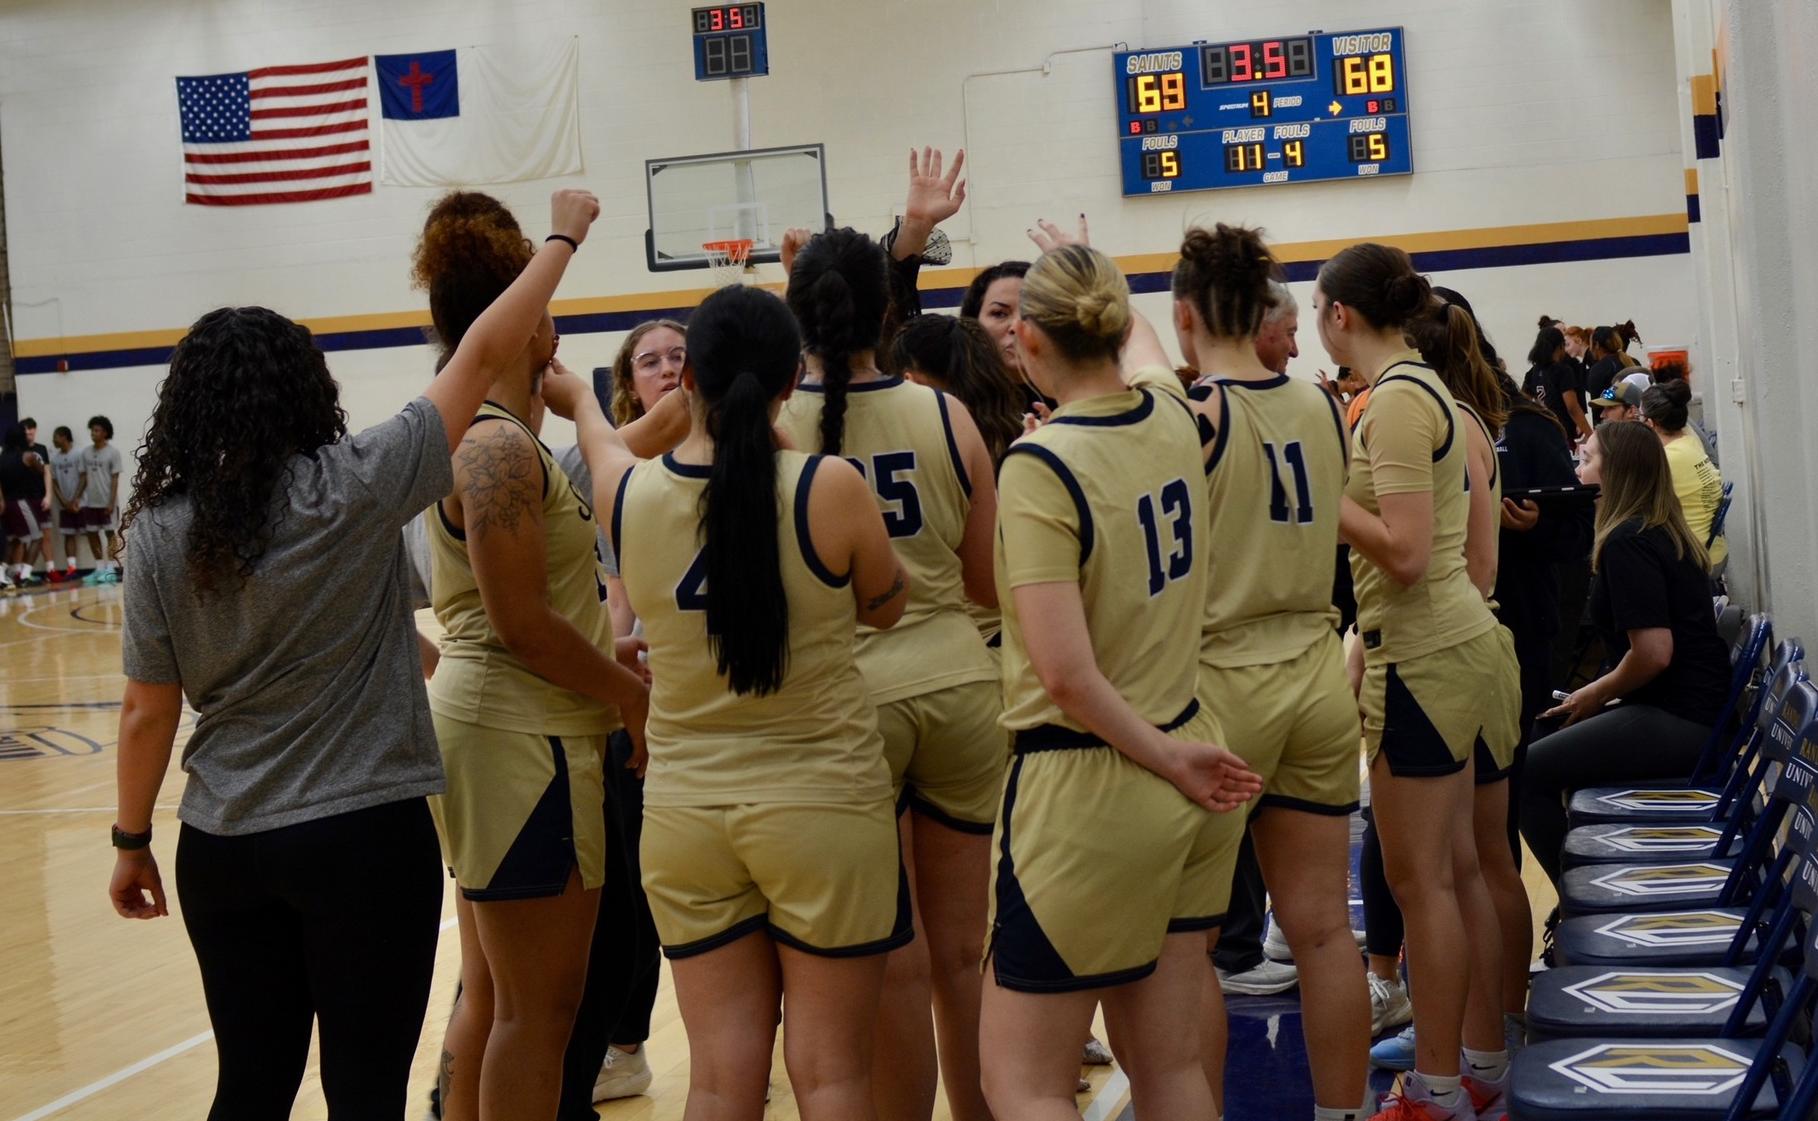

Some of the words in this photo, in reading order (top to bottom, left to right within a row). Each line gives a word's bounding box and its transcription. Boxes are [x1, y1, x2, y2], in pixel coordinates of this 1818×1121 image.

[1332, 32, 1392, 56] VISITOR
[1127, 52, 1182, 74] SAINTS
[1343, 53, 1393, 95] 68
[1137, 72, 1185, 113] 69
[1253, 91, 1269, 116] 4
[1273, 95, 1303, 109] PERIOD
[1222, 127, 1266, 144] PLAYER
[1273, 123, 1311, 140] FOULS
[1349, 117, 1387, 134] FOULS
[1141, 134, 1178, 151] FOULS
[1368, 133, 1386, 160] 5
[1161, 151, 1178, 177] 5
[1238, 144, 1262, 171] 11
[1285, 140, 1302, 166] 4
[1263, 170, 1289, 183] GAME
[1357, 163, 1380, 176] WON
[1150, 180, 1173, 192] WON
[844, 449, 924, 539] 5
[1262, 440, 1315, 525] 11
[1137, 477, 1193, 600] 13
